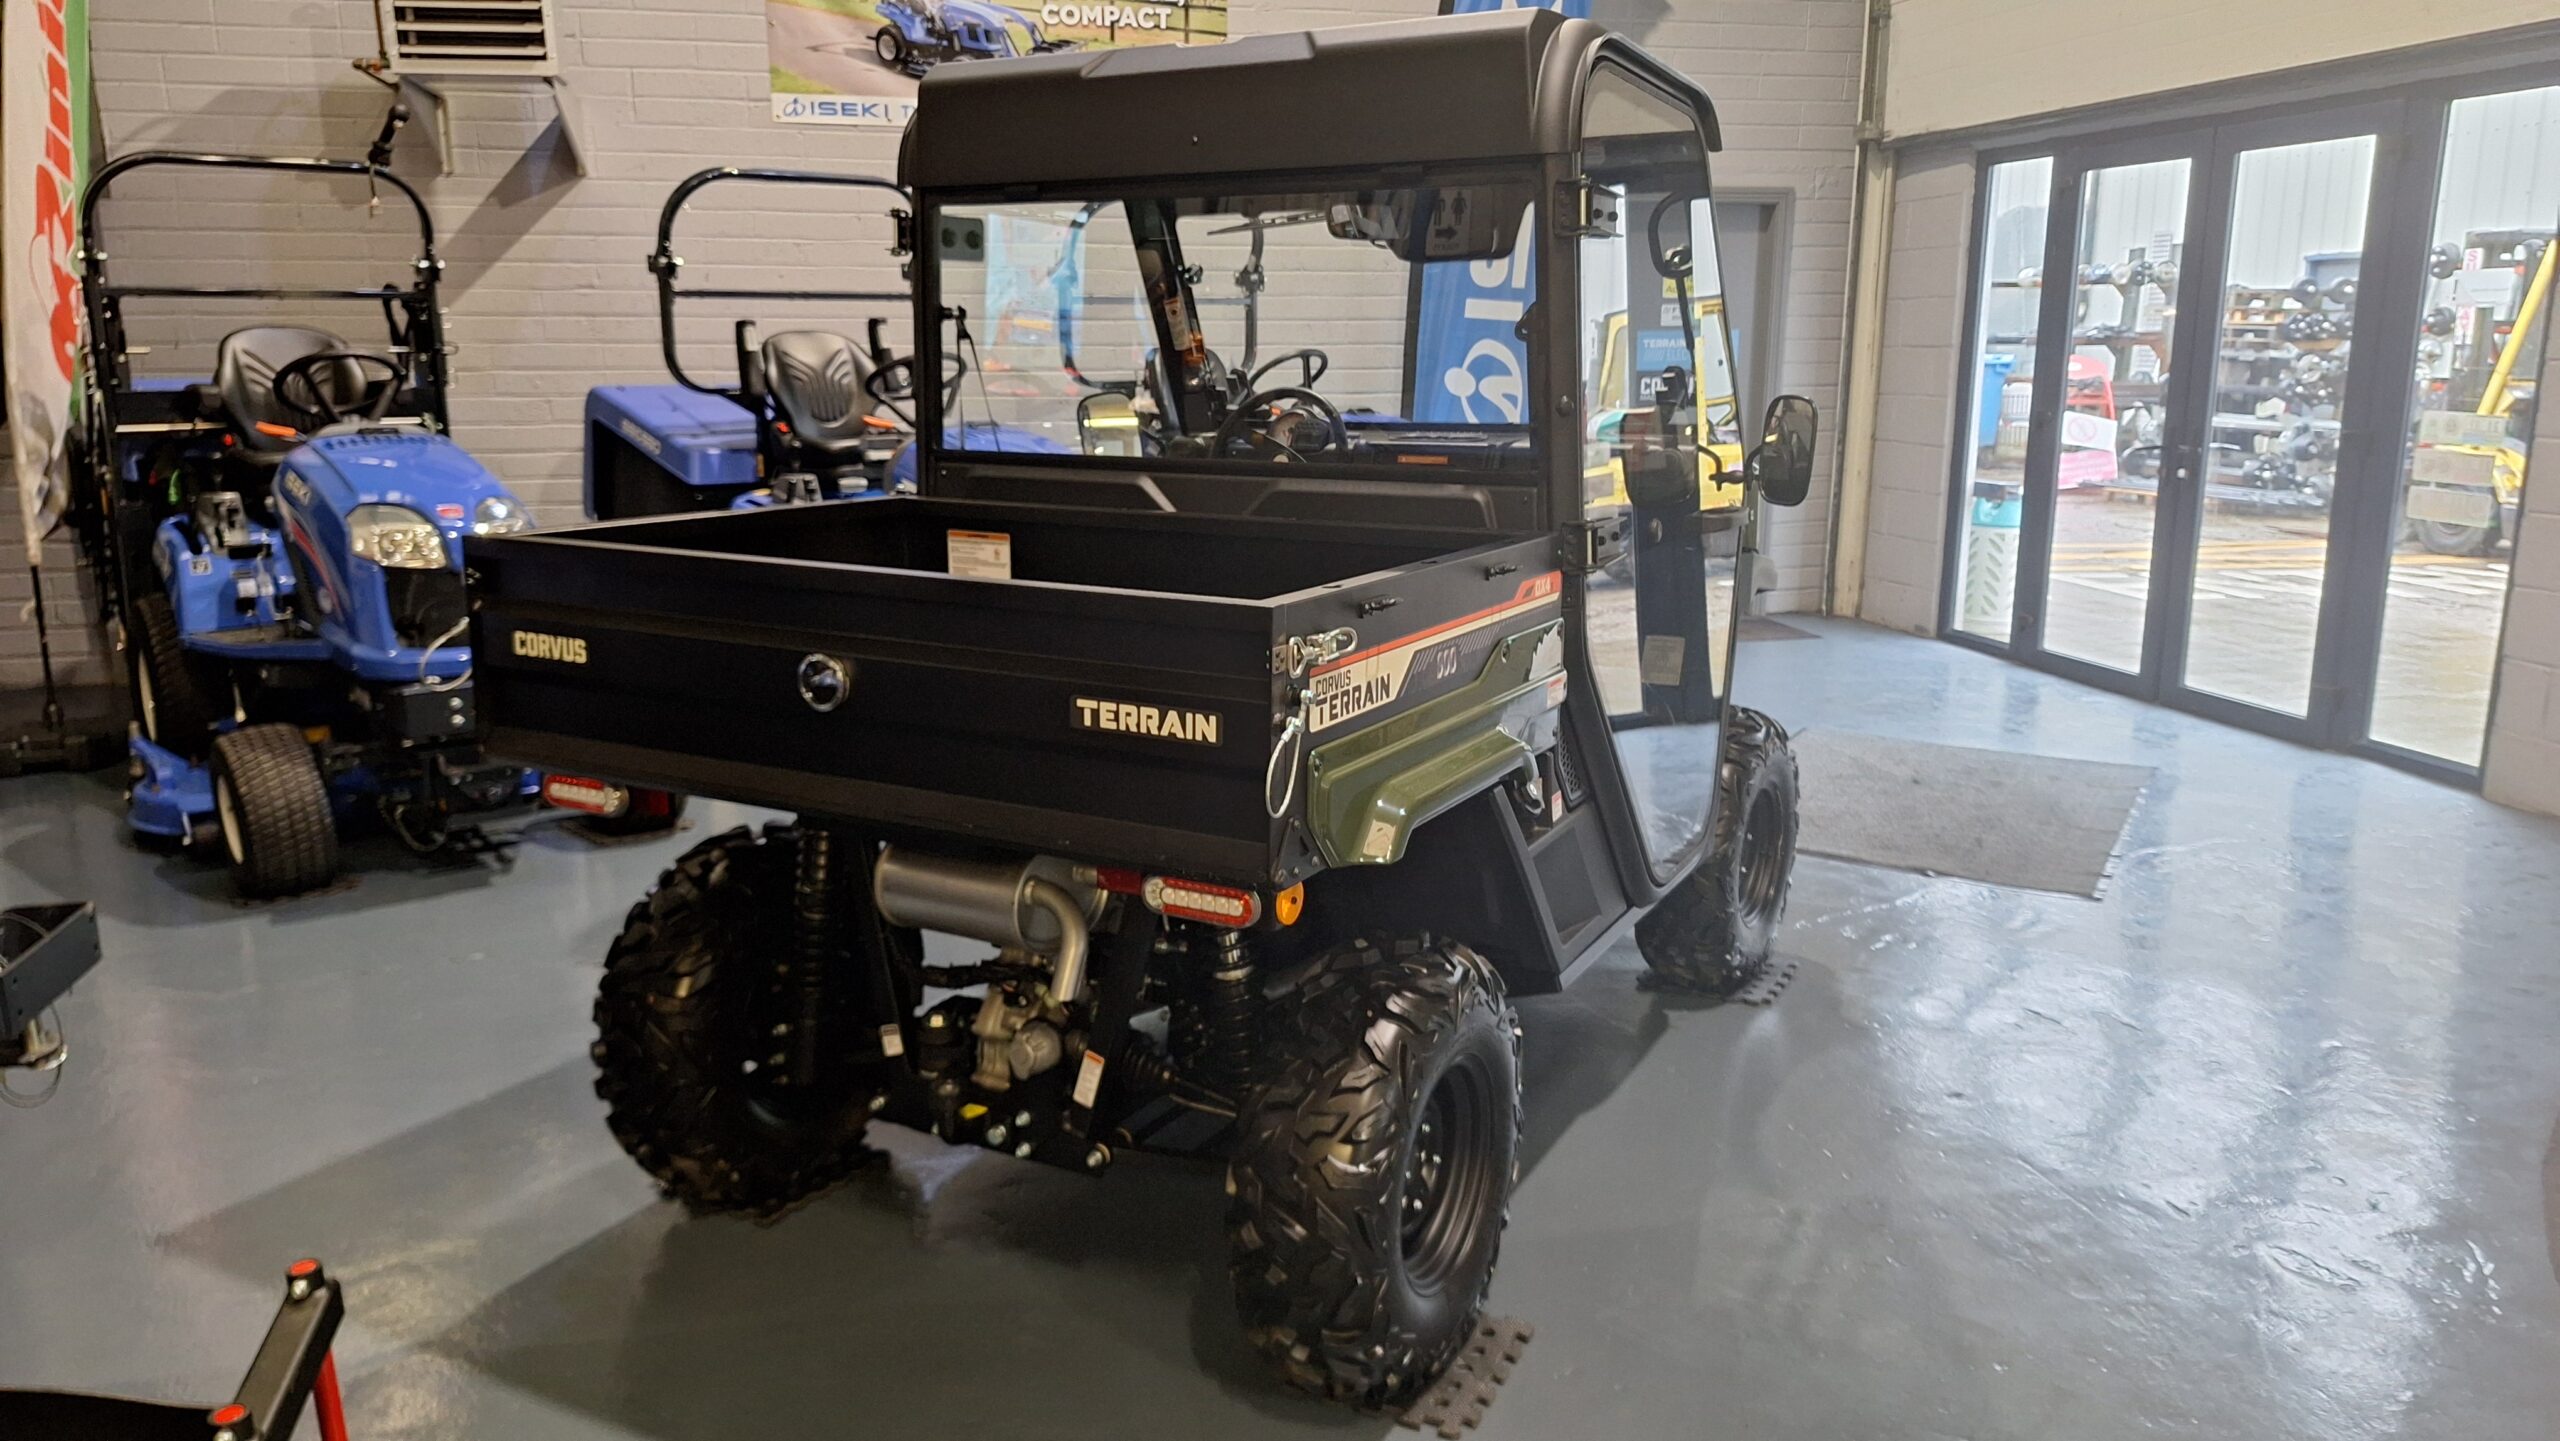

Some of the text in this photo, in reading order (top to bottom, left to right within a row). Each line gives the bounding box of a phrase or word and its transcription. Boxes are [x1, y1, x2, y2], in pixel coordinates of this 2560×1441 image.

[1041, 4, 1171, 29] COMPACT
[810, 101, 888, 118] ISEKI
[513, 630, 587, 664] CORVUS
[1315, 669, 1351, 696] CORVUS
[1314, 673, 1391, 725] TERRAIN
[1076, 698, 1216, 743] TERRAIN
